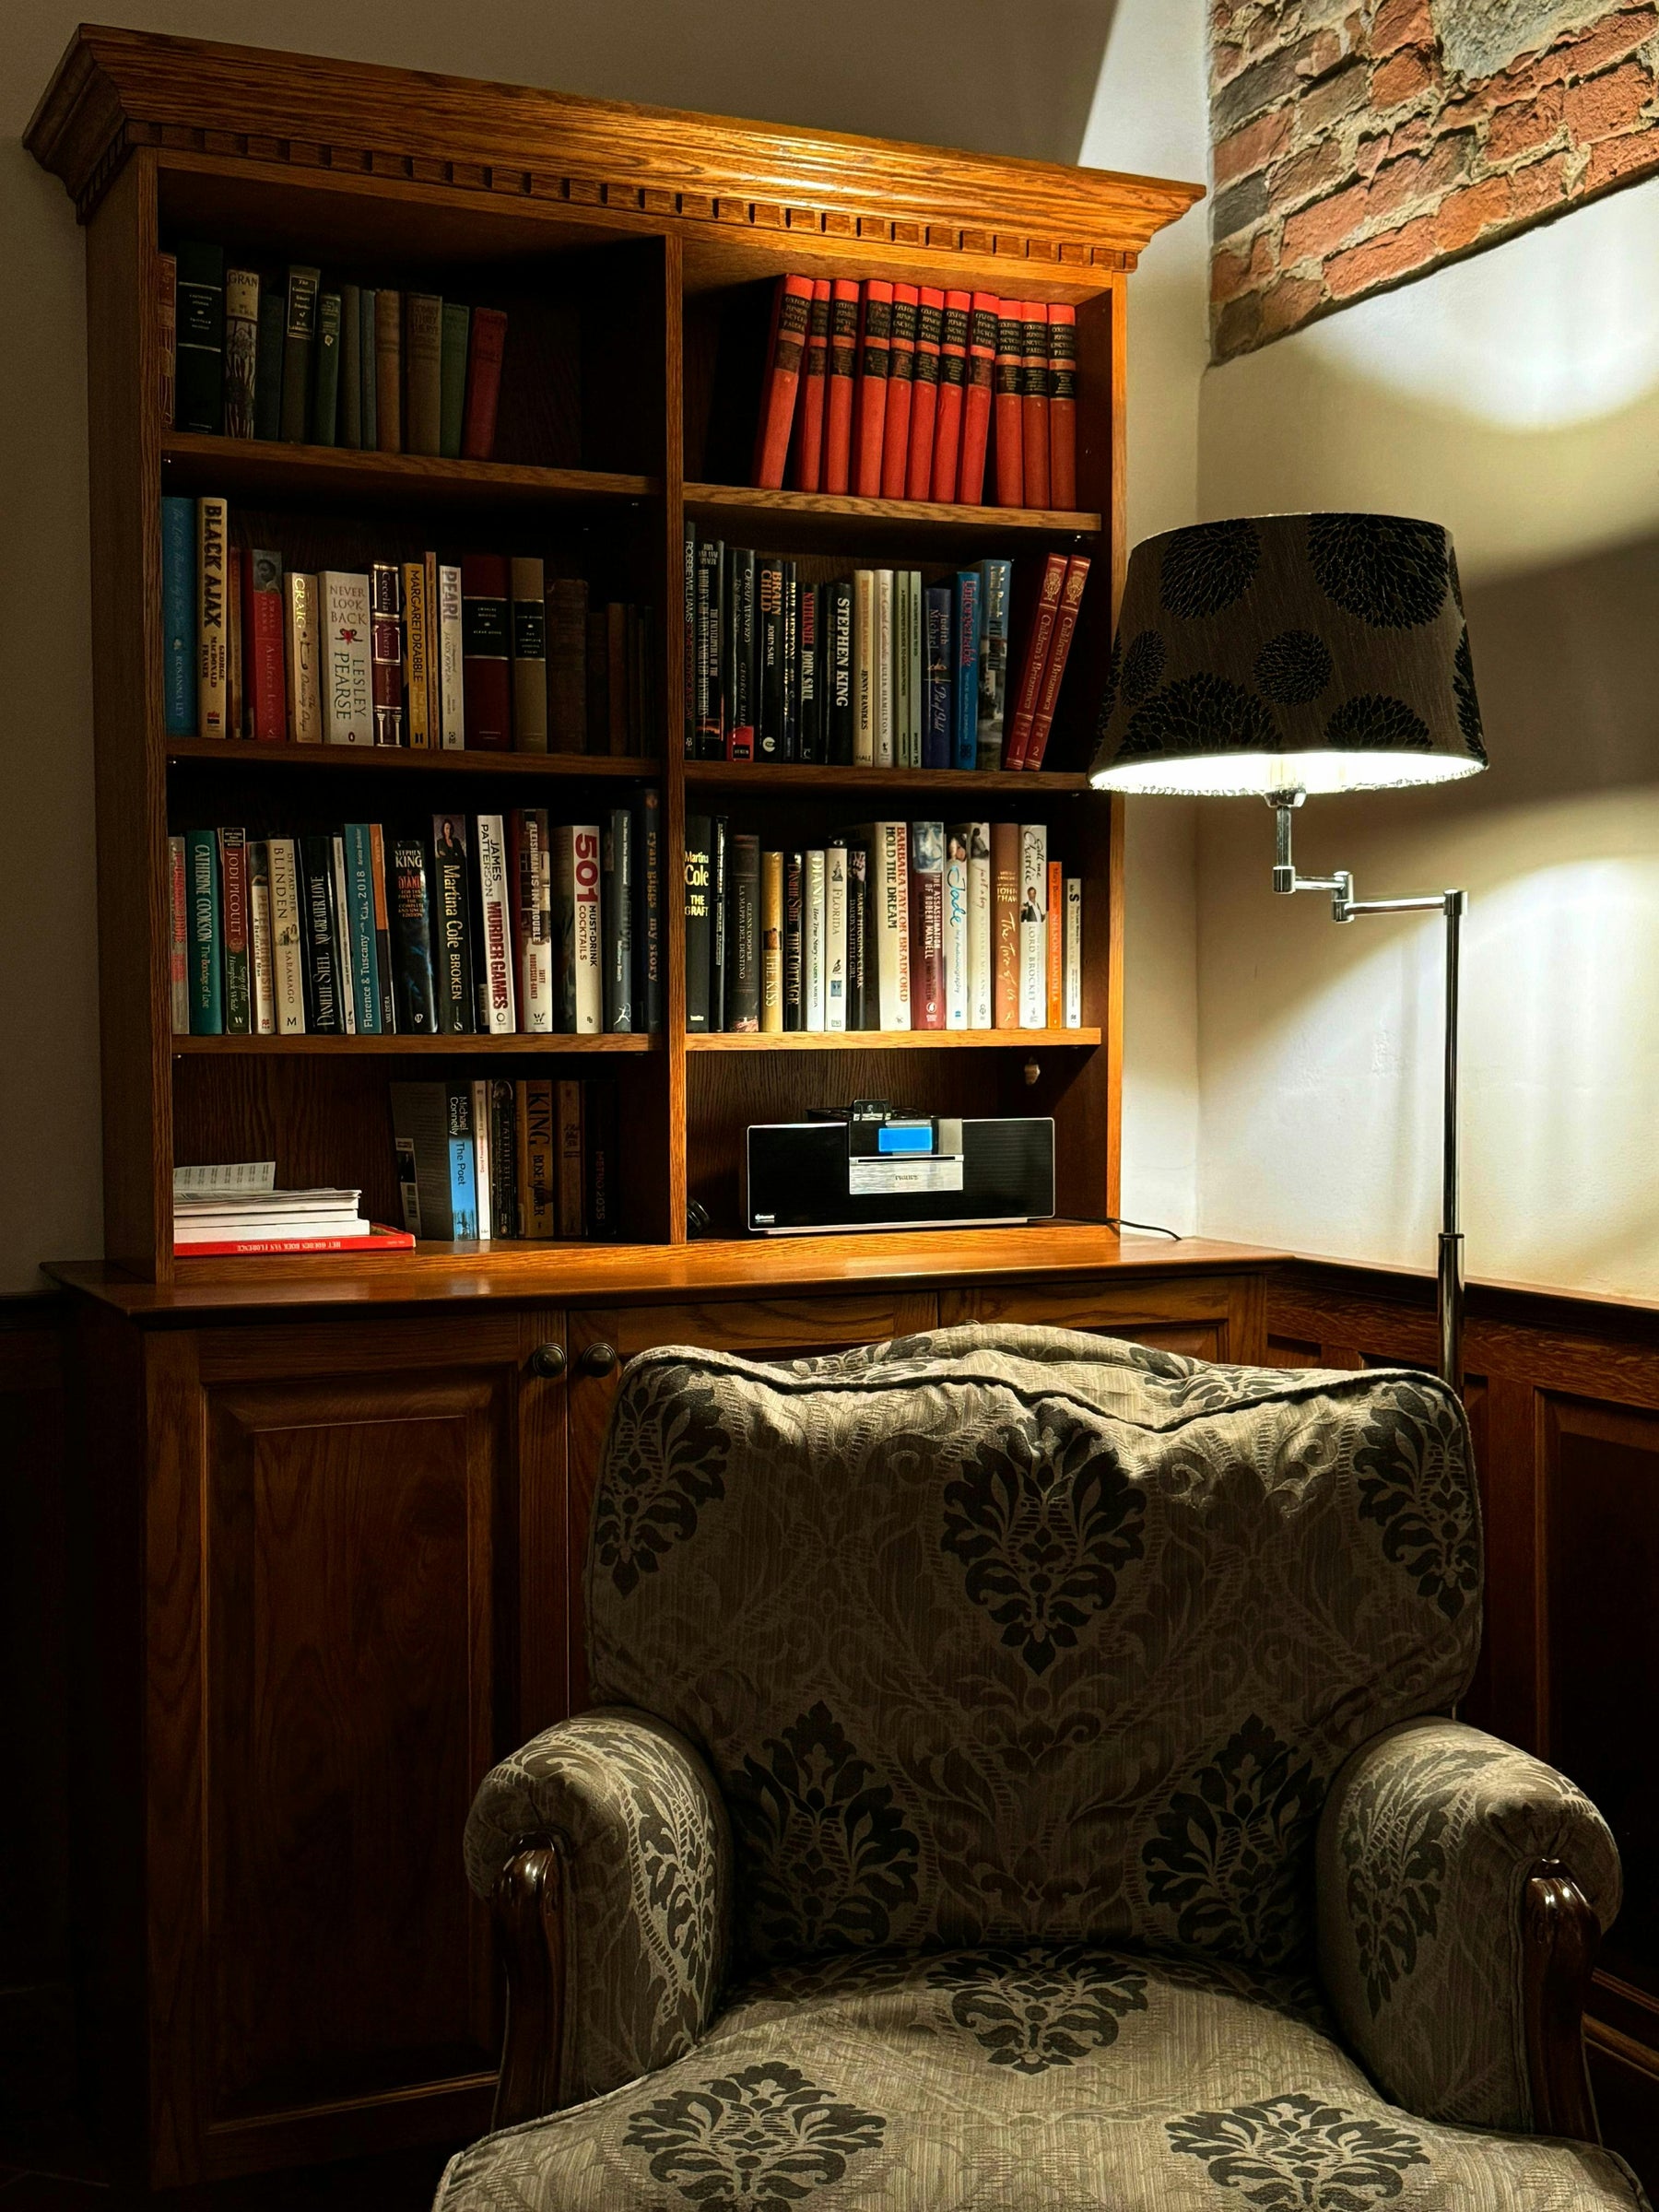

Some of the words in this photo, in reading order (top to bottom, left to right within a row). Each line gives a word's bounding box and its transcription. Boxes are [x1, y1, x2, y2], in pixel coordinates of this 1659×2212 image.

[204, 505, 222, 571] BLACK
[204, 574, 222, 629] AJAX
[295, 577, 307, 629] CRAIG
[330, 585, 366, 598] NEVER
[333, 598, 362, 610] LOOK
[382, 571, 394, 612] Cecelia
[411, 570, 422, 632] MARGARET
[442, 571, 458, 624] PEARL
[760, 569, 772, 613] CHILD
[771, 571, 782, 617] BRAIN
[331, 611, 367, 625] BACK
[767, 622, 775, 645] JOHN
[801, 592, 815, 645] NATHANIEL
[836, 596, 851, 667] STEPHEN
[929, 608, 939, 650] Michael
[939, 613, 949, 646] Judith
[382, 624, 394, 658] Ahern
[1033, 614, 1053, 660] Children's
[1054, 617, 1073, 663] Children's
[201, 644, 210, 679] FRASER
[412, 633, 423, 683] DRABBLE
[767, 646, 776, 667] SAUL
[800, 650, 815, 677] JOHN
[334, 652, 352, 721] PEARSE
[352, 659, 366, 717] LESLEY
[801, 677, 815, 702] SAUL
[835, 669, 850, 708] KING
[861, 669, 869, 694] JENNY
[1024, 662, 1042, 710] Britannica
[1043, 664, 1063, 711] Britannica
[175, 702, 184, 718] LEY
[861, 695, 869, 731] RANDLES
[1032, 746, 1041, 757] 2
[489, 839, 502, 881] JAMES
[529, 823, 539, 873] FLEISHMAN
[647, 831, 658, 866] ryan
[685, 850, 710, 864] Martina
[886, 826, 897, 858] HOLD
[897, 827, 907, 886] BARBARA
[1023, 830, 1037, 884] Charlie
[1035, 838, 1044, 862] Call
[194, 844, 212, 895] CATHERINE
[227, 852, 240, 880] JODI
[394, 855, 422, 868] KING
[480, 824, 493, 897] PATTERSON
[576, 833, 598, 902] 501
[685, 865, 710, 887] Cole
[886, 861, 897, 883] THE
[1036, 862, 1042, 879] me
[274, 848, 288, 919] BLINDEN
[310, 877, 325, 900] LOVE
[357, 870, 368, 899] 2018
[443, 864, 462, 915] Martina
[531, 875, 539, 886] IS
[531, 888, 540, 901] IN
[646, 870, 659, 909] giggs
[738, 885, 746, 896] LA
[811, 856, 823, 905] DIANA
[924, 883, 934, 892] OF
[948, 866, 966, 928] Jade
[1069, 893, 1080, 902] S
[229, 883, 241, 935] PICOULT
[312, 900, 331, 933] GREATER
[684, 906, 710, 917] GRAFT
[689, 894, 705, 906] THE
[832, 888, 842, 935] FLORIDA
[856, 891, 865, 916] MARY
[887, 887, 898, 929] DREAM
[898, 888, 908, 933] TAYLOR
[924, 895, 934, 923] ROBERT
[196, 898, 213, 942] COOKSON
[446, 920, 464, 948] Cole
[487, 900, 504, 959] MURDER
[532, 903, 541, 943] TROUBLE
[579, 904, 587, 960] COCKTAILS
[589, 904, 598, 967] MUST-DRINK
[647, 917, 658, 940] my
[933, 890, 941, 948] ASSASSINATION
[1001, 912, 1017, 942] The
[201, 944, 211, 959] The
[314, 935, 332, 945] NO
[359, 935, 371, 975] Tuscany
[787, 931, 800, 953] THE
[811, 937, 819, 955] Story
[856, 918, 865, 957] HIGGINS
[924, 924, 934, 959] MAXWELL
[286, 950, 295, 1004] SARAMAGO
[312, 952, 331, 983] STEEL
[450, 952, 463, 1000] BROKEN
[648, 943, 659, 982] story
[766, 955, 779, 977] THE
[787, 955, 801, 1005] COTTAGE
[856, 959, 865, 988] CLARK
[899, 935, 909, 1001] BRADFORD
[1028, 956, 1036, 1001] BROCKET
[230, 991, 239, 1012] Whale
[490, 960, 509, 1009] GAMES
[766, 980, 780, 1007] KISS
[316, 987, 335, 1027] DANIELLE
[364, 986, 373, 1029] Florence
[449, 1096, 460, 1135] Connelly
[458, 1096, 469, 1130] Michael
[528, 1092, 550, 1146] KING
[456, 1142, 465, 1160] The
[533, 1155, 546, 1178] ROSE
[457, 1162, 466, 1185] Poet
[595, 1150, 605, 1190] METRO
[595, 1191, 606, 1220] 2035
[269, 1243, 281, 1252] VAN
[283, 1242, 300, 1251] BOEK
[328, 1241, 341, 1249] HET
